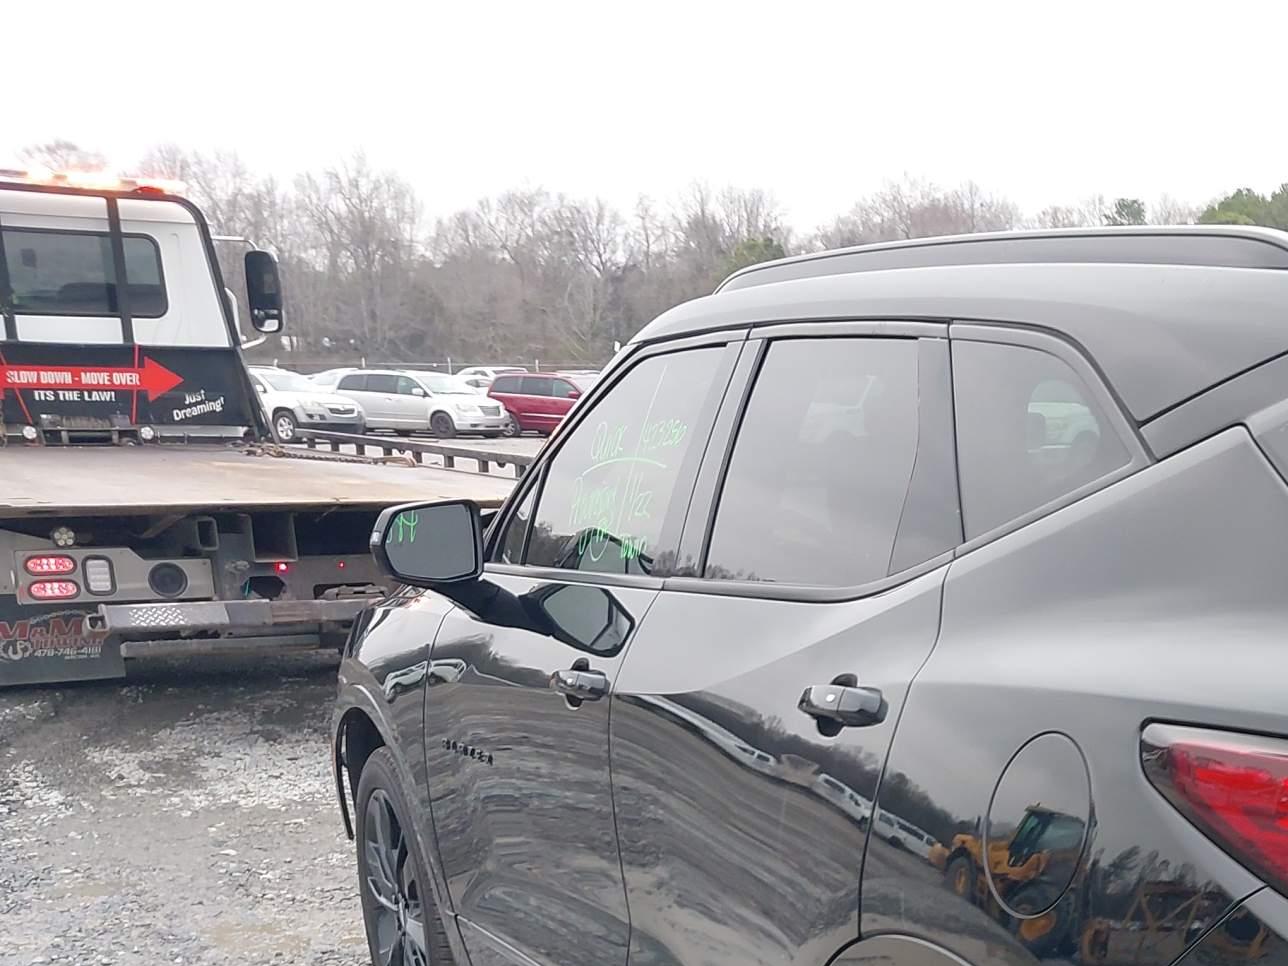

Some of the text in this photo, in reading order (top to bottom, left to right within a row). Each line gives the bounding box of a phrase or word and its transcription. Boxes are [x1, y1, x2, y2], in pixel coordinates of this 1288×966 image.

[6, 370, 37, 384] SLOW
[40, 371, 73, 384] DOWN
[81, 372, 111, 385] MOVE
[112, 373, 141, 386] OVER
[34, 390, 116, 402] ITS THE LAW!
[184, 389, 206, 405] Just
